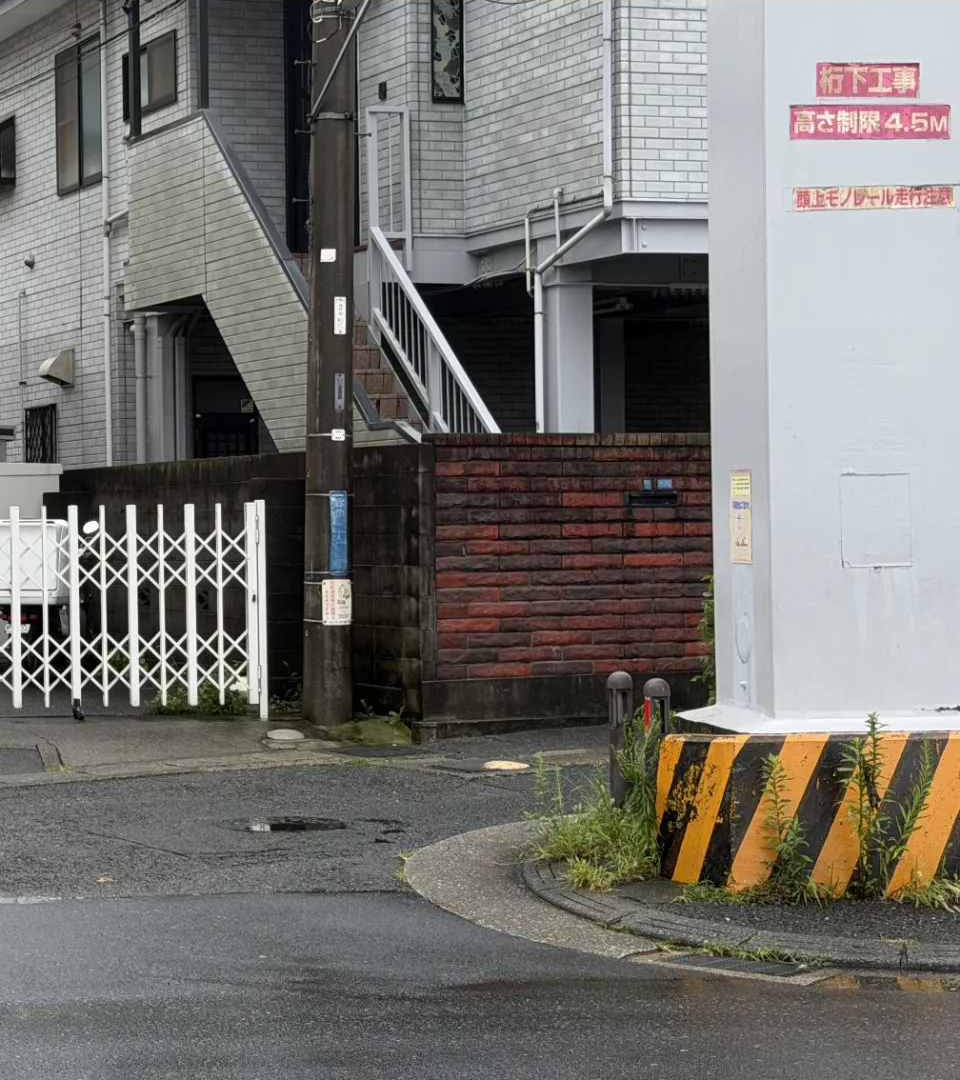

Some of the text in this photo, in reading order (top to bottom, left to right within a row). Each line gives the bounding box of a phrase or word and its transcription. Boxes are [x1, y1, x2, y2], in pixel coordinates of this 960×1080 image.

[819, 66, 917, 94] 桁下工事
[796, 186, 953, 209] 頭上モノレール走行注意
